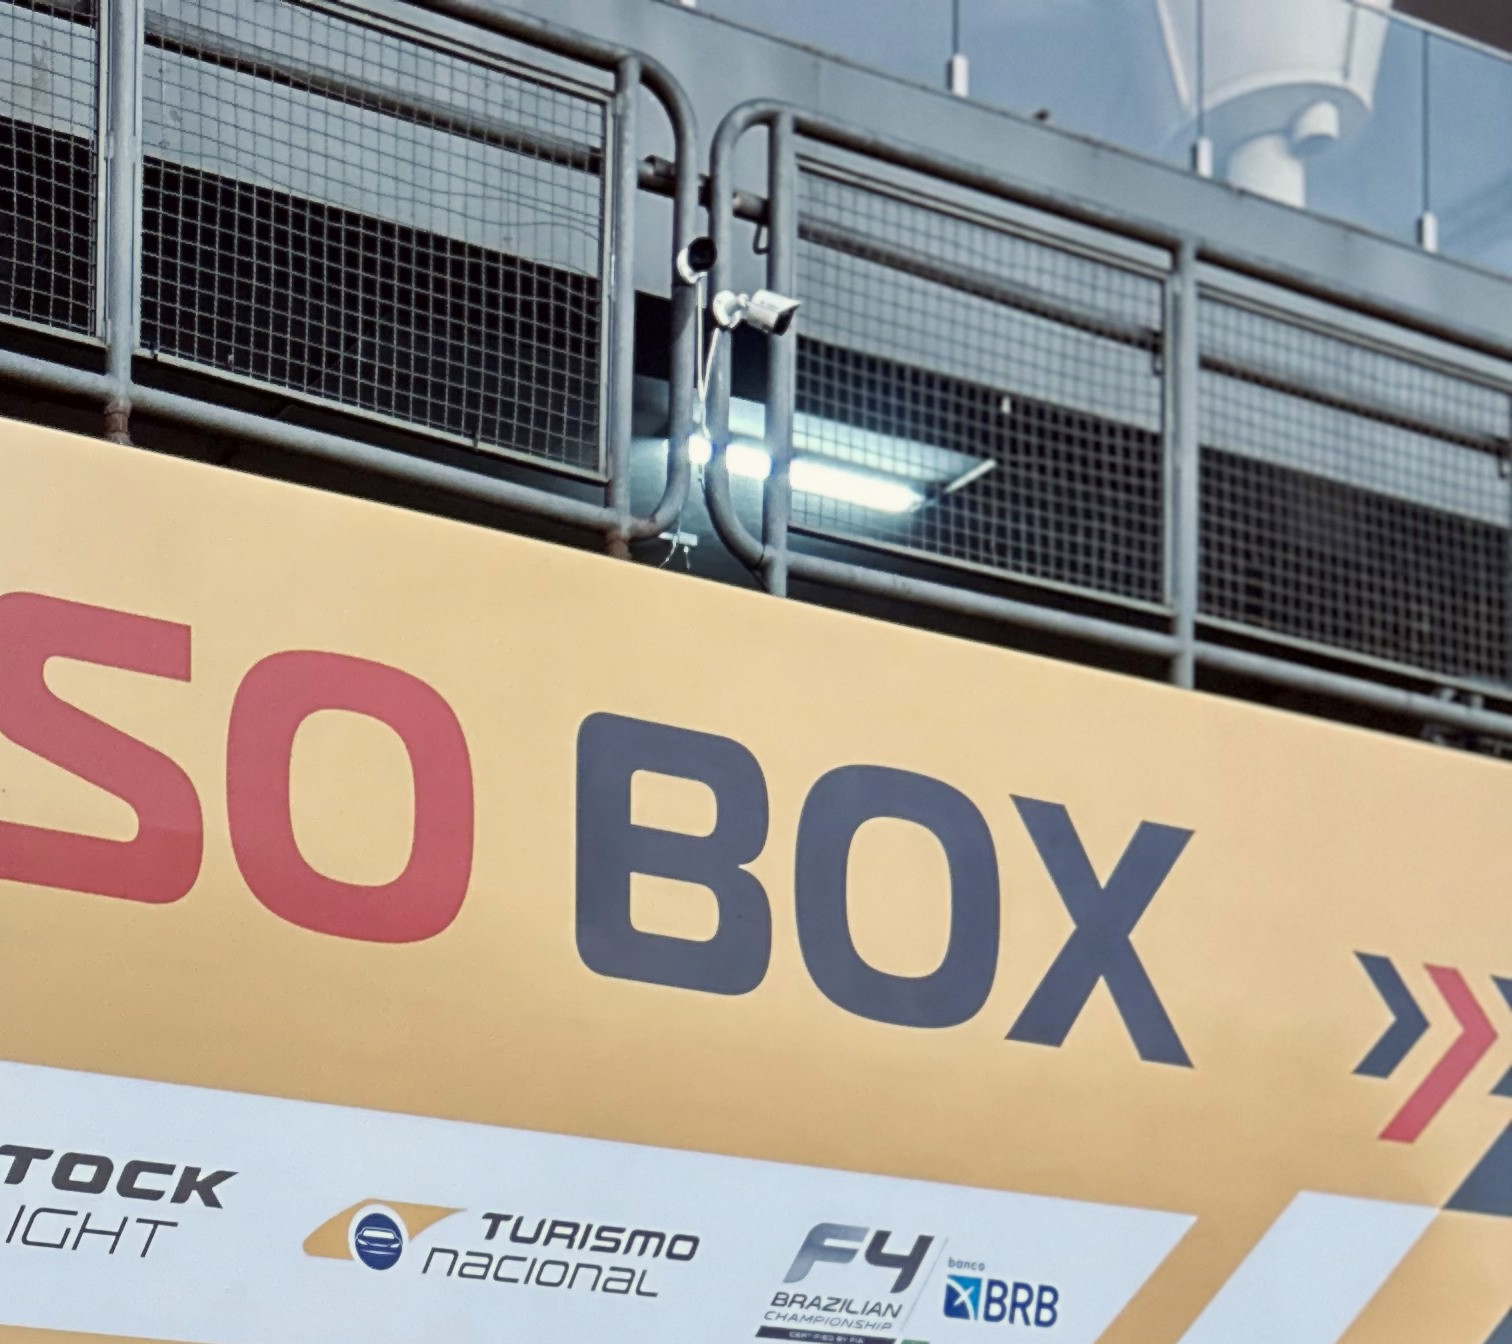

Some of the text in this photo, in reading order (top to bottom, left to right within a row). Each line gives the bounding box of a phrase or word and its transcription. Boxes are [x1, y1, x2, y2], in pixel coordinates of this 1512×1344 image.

[574, 710, 1196, 1070] BOX
[481, 1212, 701, 1262] TURISMO
[782, 1221, 935, 1294] F4
[947, 1256, 986, 1272] banco
[763, 1310, 893, 1332] CHAMPIONSHIP
[770, 1291, 903, 1319] BRAZILIAN
[982, 1278, 1060, 1328] BRB
